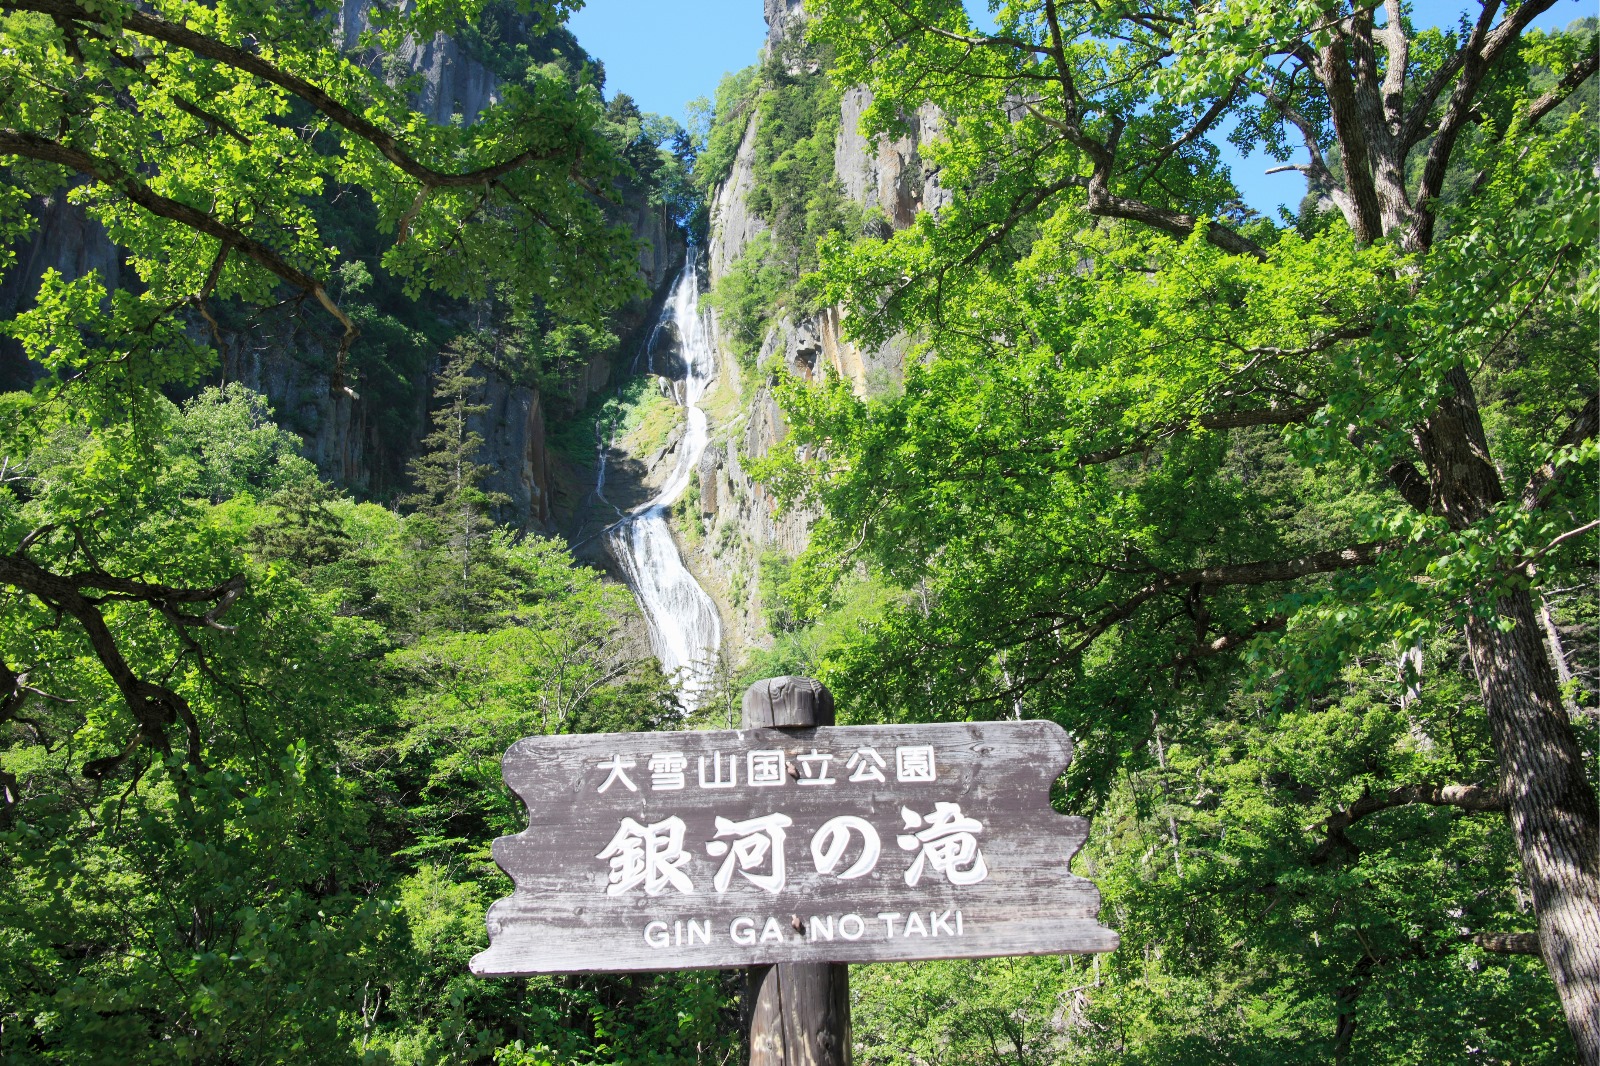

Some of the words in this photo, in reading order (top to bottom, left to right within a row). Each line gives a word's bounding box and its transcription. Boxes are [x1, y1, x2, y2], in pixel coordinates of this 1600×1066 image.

[596, 744, 937, 794] 大雪山国立公園
[595, 801, 990, 898] 銀河の滝
[643, 918, 712, 949] GIN
[729, 915, 785, 946] GA
[810, 913, 866, 943] NO
[876, 909, 965, 939] TAKI
